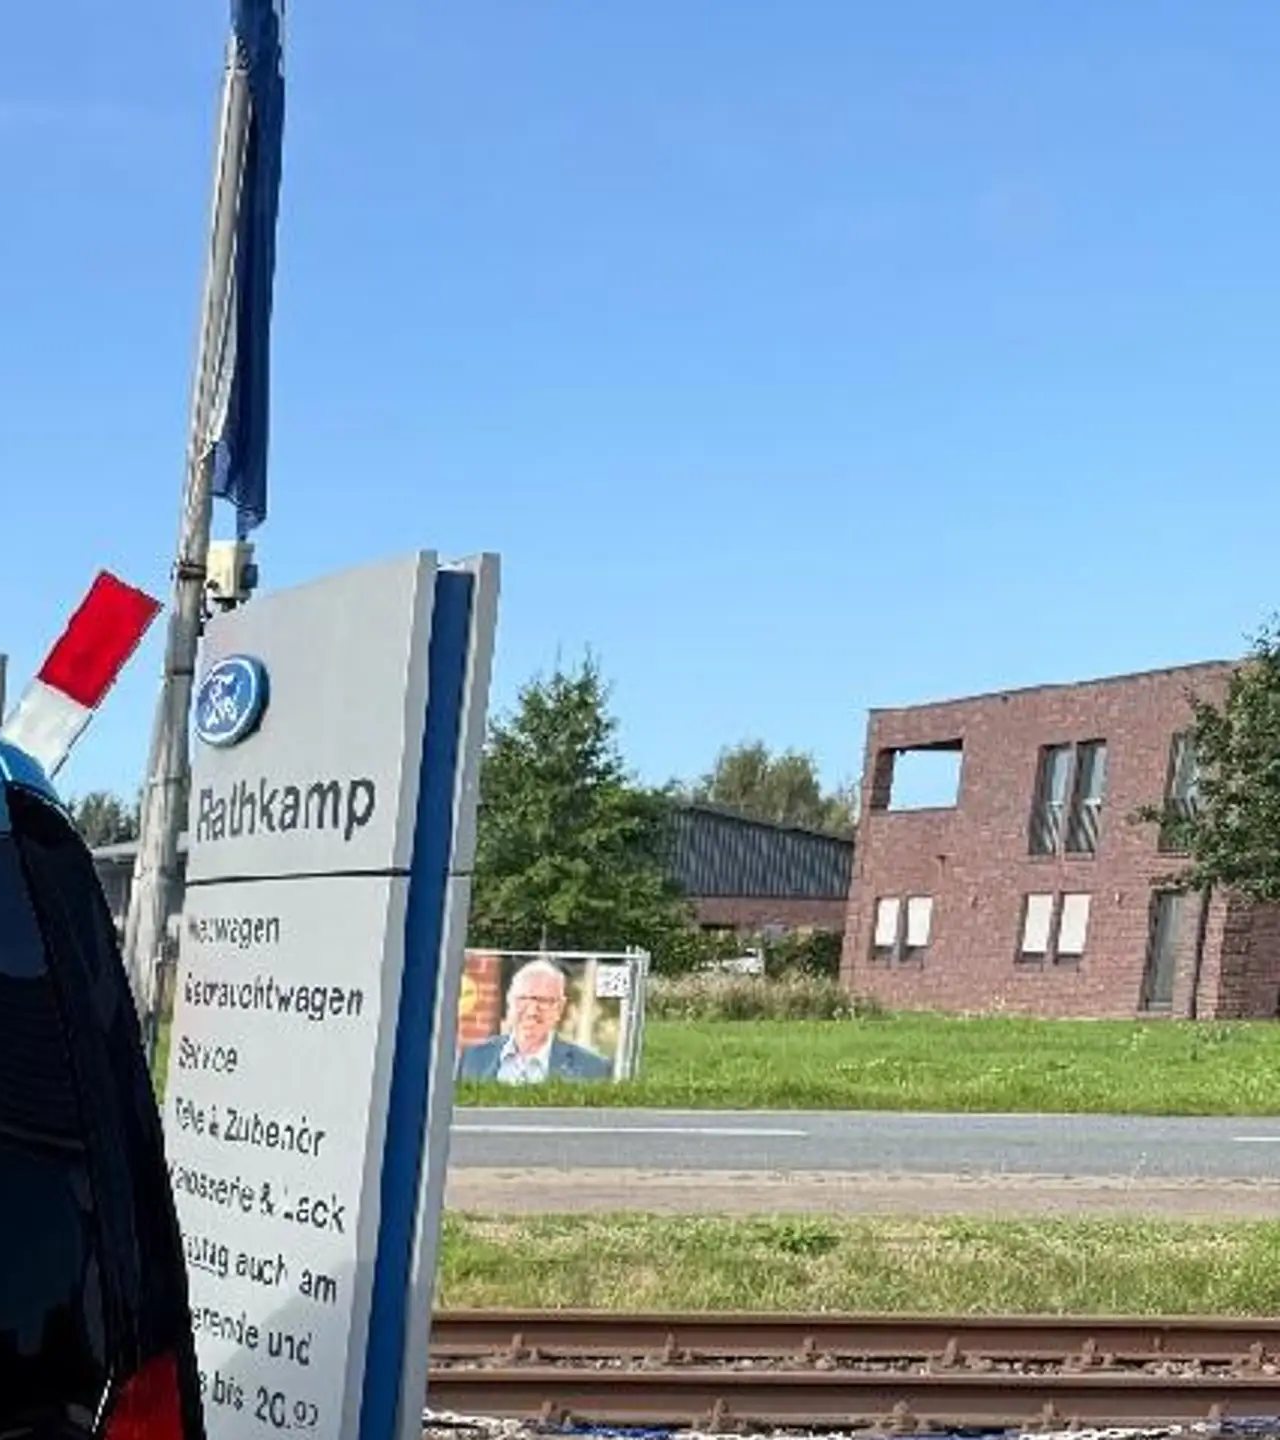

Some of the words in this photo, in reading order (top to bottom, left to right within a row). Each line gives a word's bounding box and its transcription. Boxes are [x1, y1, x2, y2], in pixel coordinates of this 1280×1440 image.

[197, 777, 377, 842] Rathkamp
[235, 1252, 290, 1288] auch
[298, 1267, 338, 1304] am
[267, 1330, 314, 1367] und
[211, 1369, 244, 1412] bis
